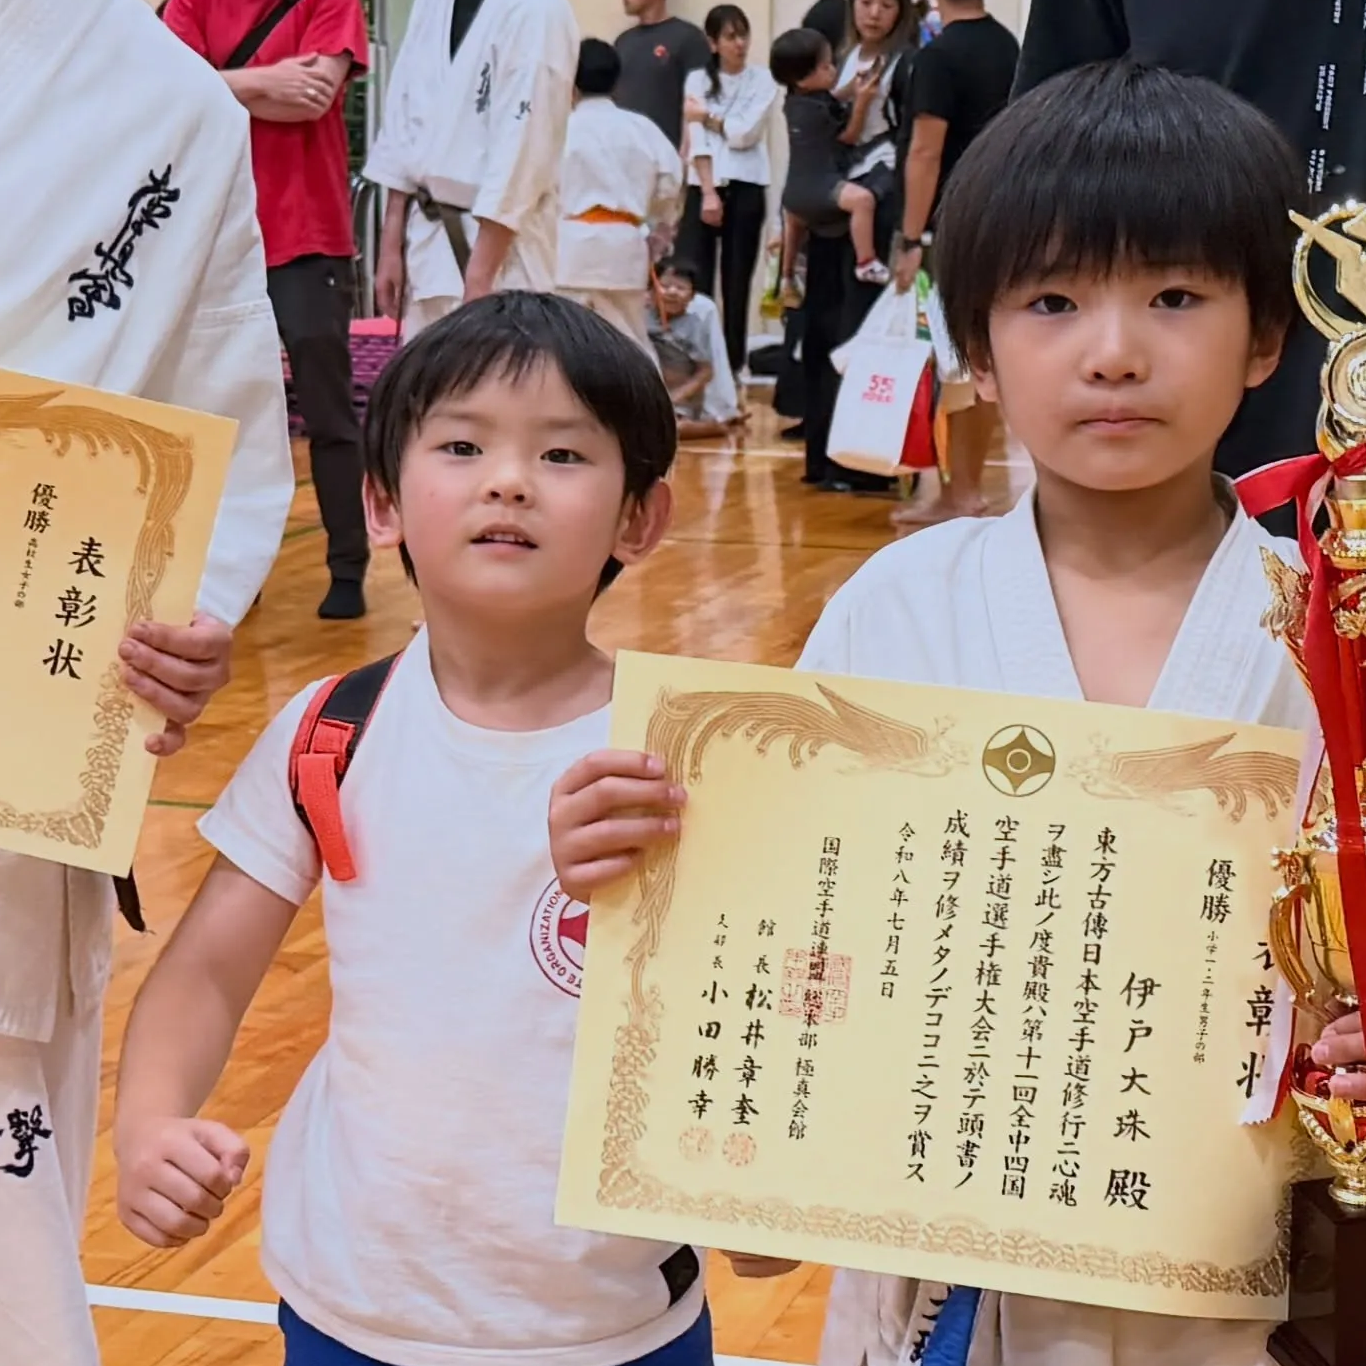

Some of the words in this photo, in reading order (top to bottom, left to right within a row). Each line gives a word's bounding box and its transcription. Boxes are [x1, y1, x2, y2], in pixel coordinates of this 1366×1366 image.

[24, 482, 58, 534] 優勝
[42, 536, 107, 680] 表彰状
[880, 822, 916, 1000] 令和八年七月五日
[1200, 857, 1237, 924] 優勝
